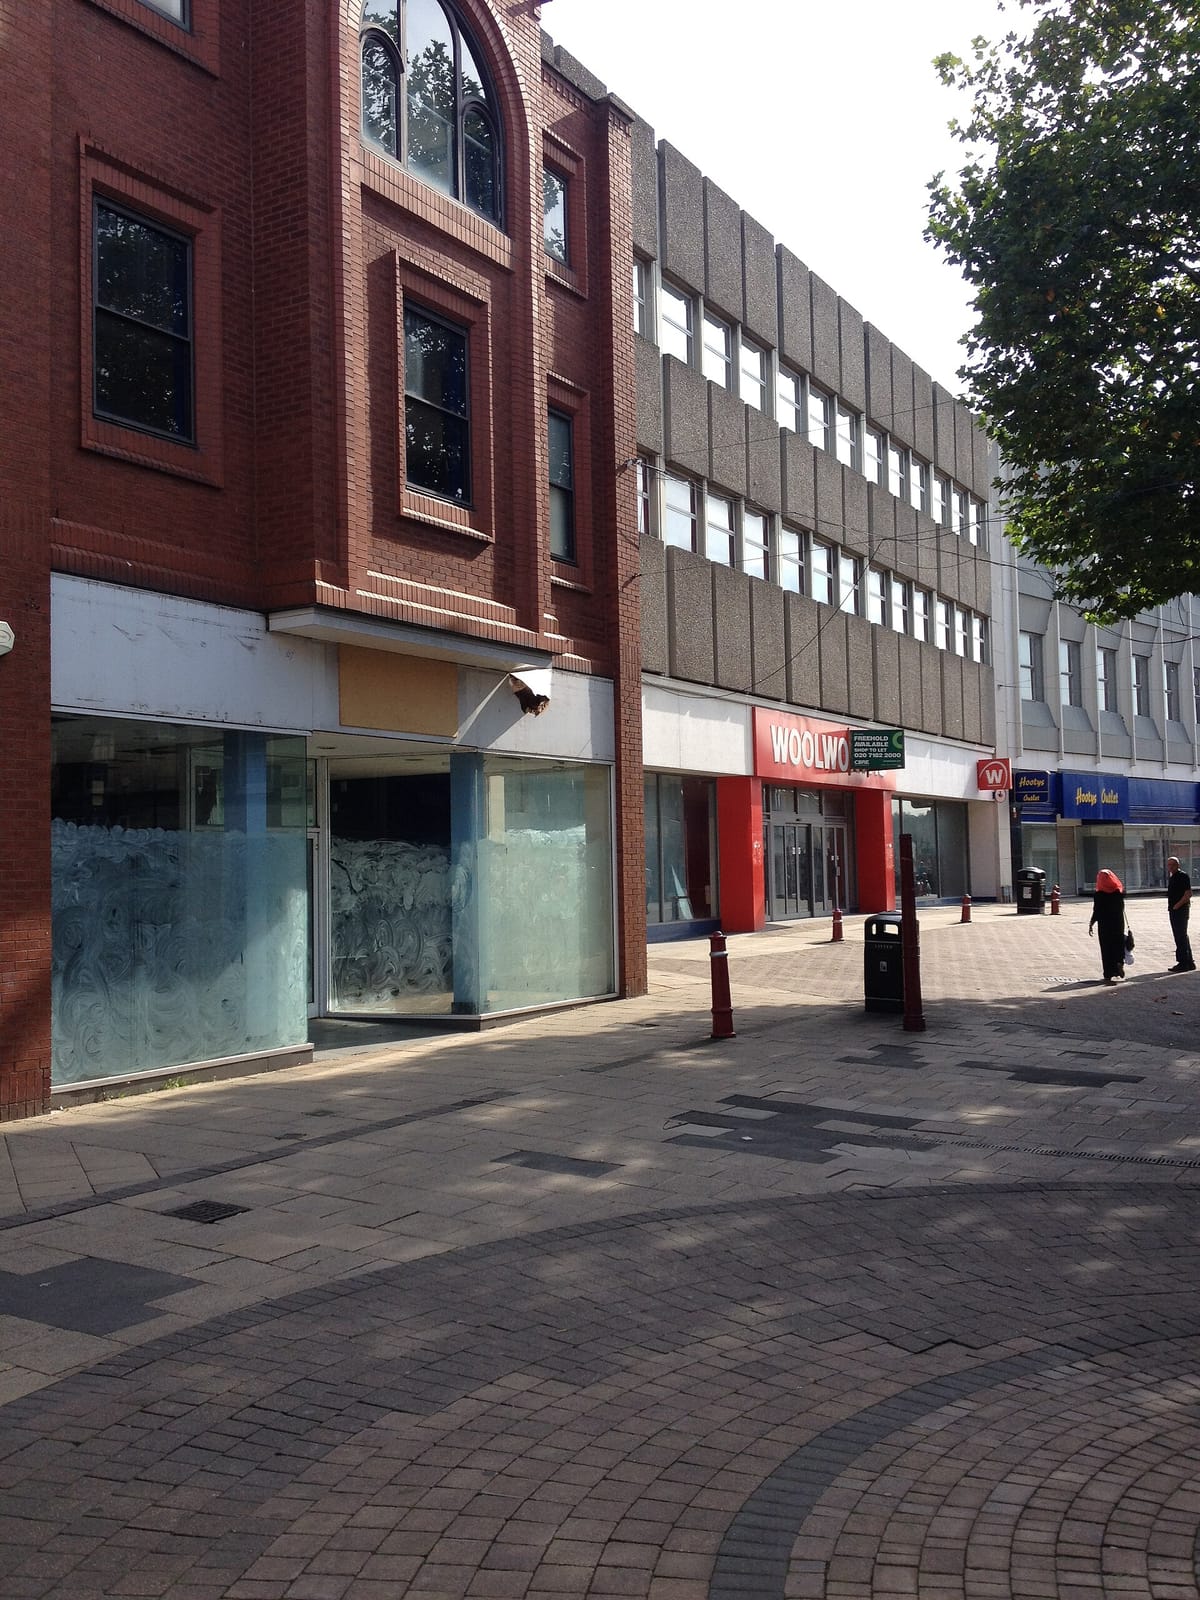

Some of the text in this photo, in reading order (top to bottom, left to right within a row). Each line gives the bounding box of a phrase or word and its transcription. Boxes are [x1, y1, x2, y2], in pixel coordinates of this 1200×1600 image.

[985, 769, 1003, 784] W
[1019, 776, 1045, 788] Hootys
[1075, 786, 1119, 806] Hootys Outlet
